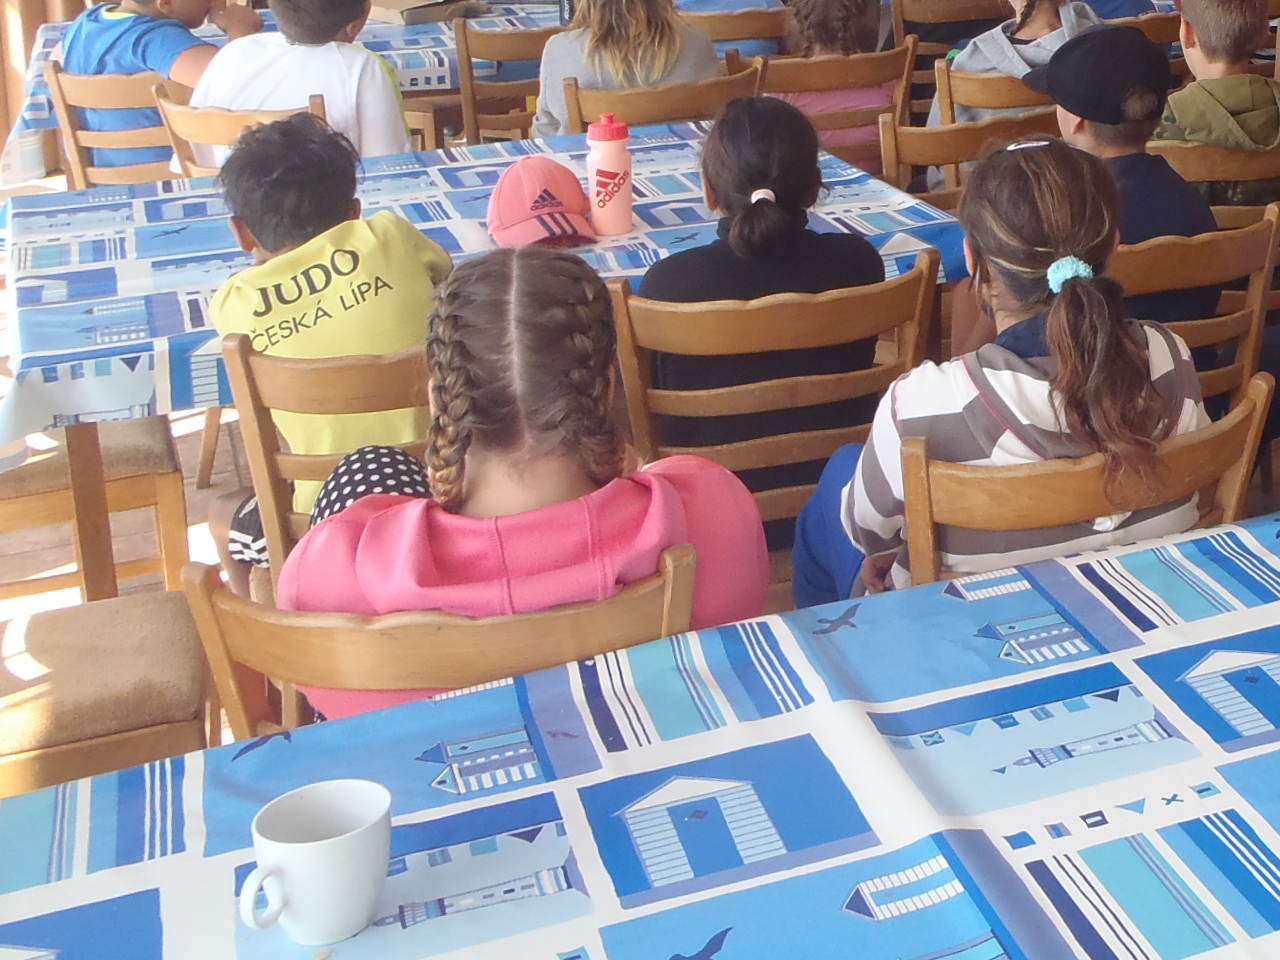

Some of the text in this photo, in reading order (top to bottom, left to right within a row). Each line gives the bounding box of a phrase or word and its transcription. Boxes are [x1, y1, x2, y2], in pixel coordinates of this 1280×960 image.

[530, 200, 564, 211] adidas
[597, 170, 629, 209] adidas
[253, 249, 360, 317] JUDO
[251, 276, 394, 353] ČESKÁ LÍPA
